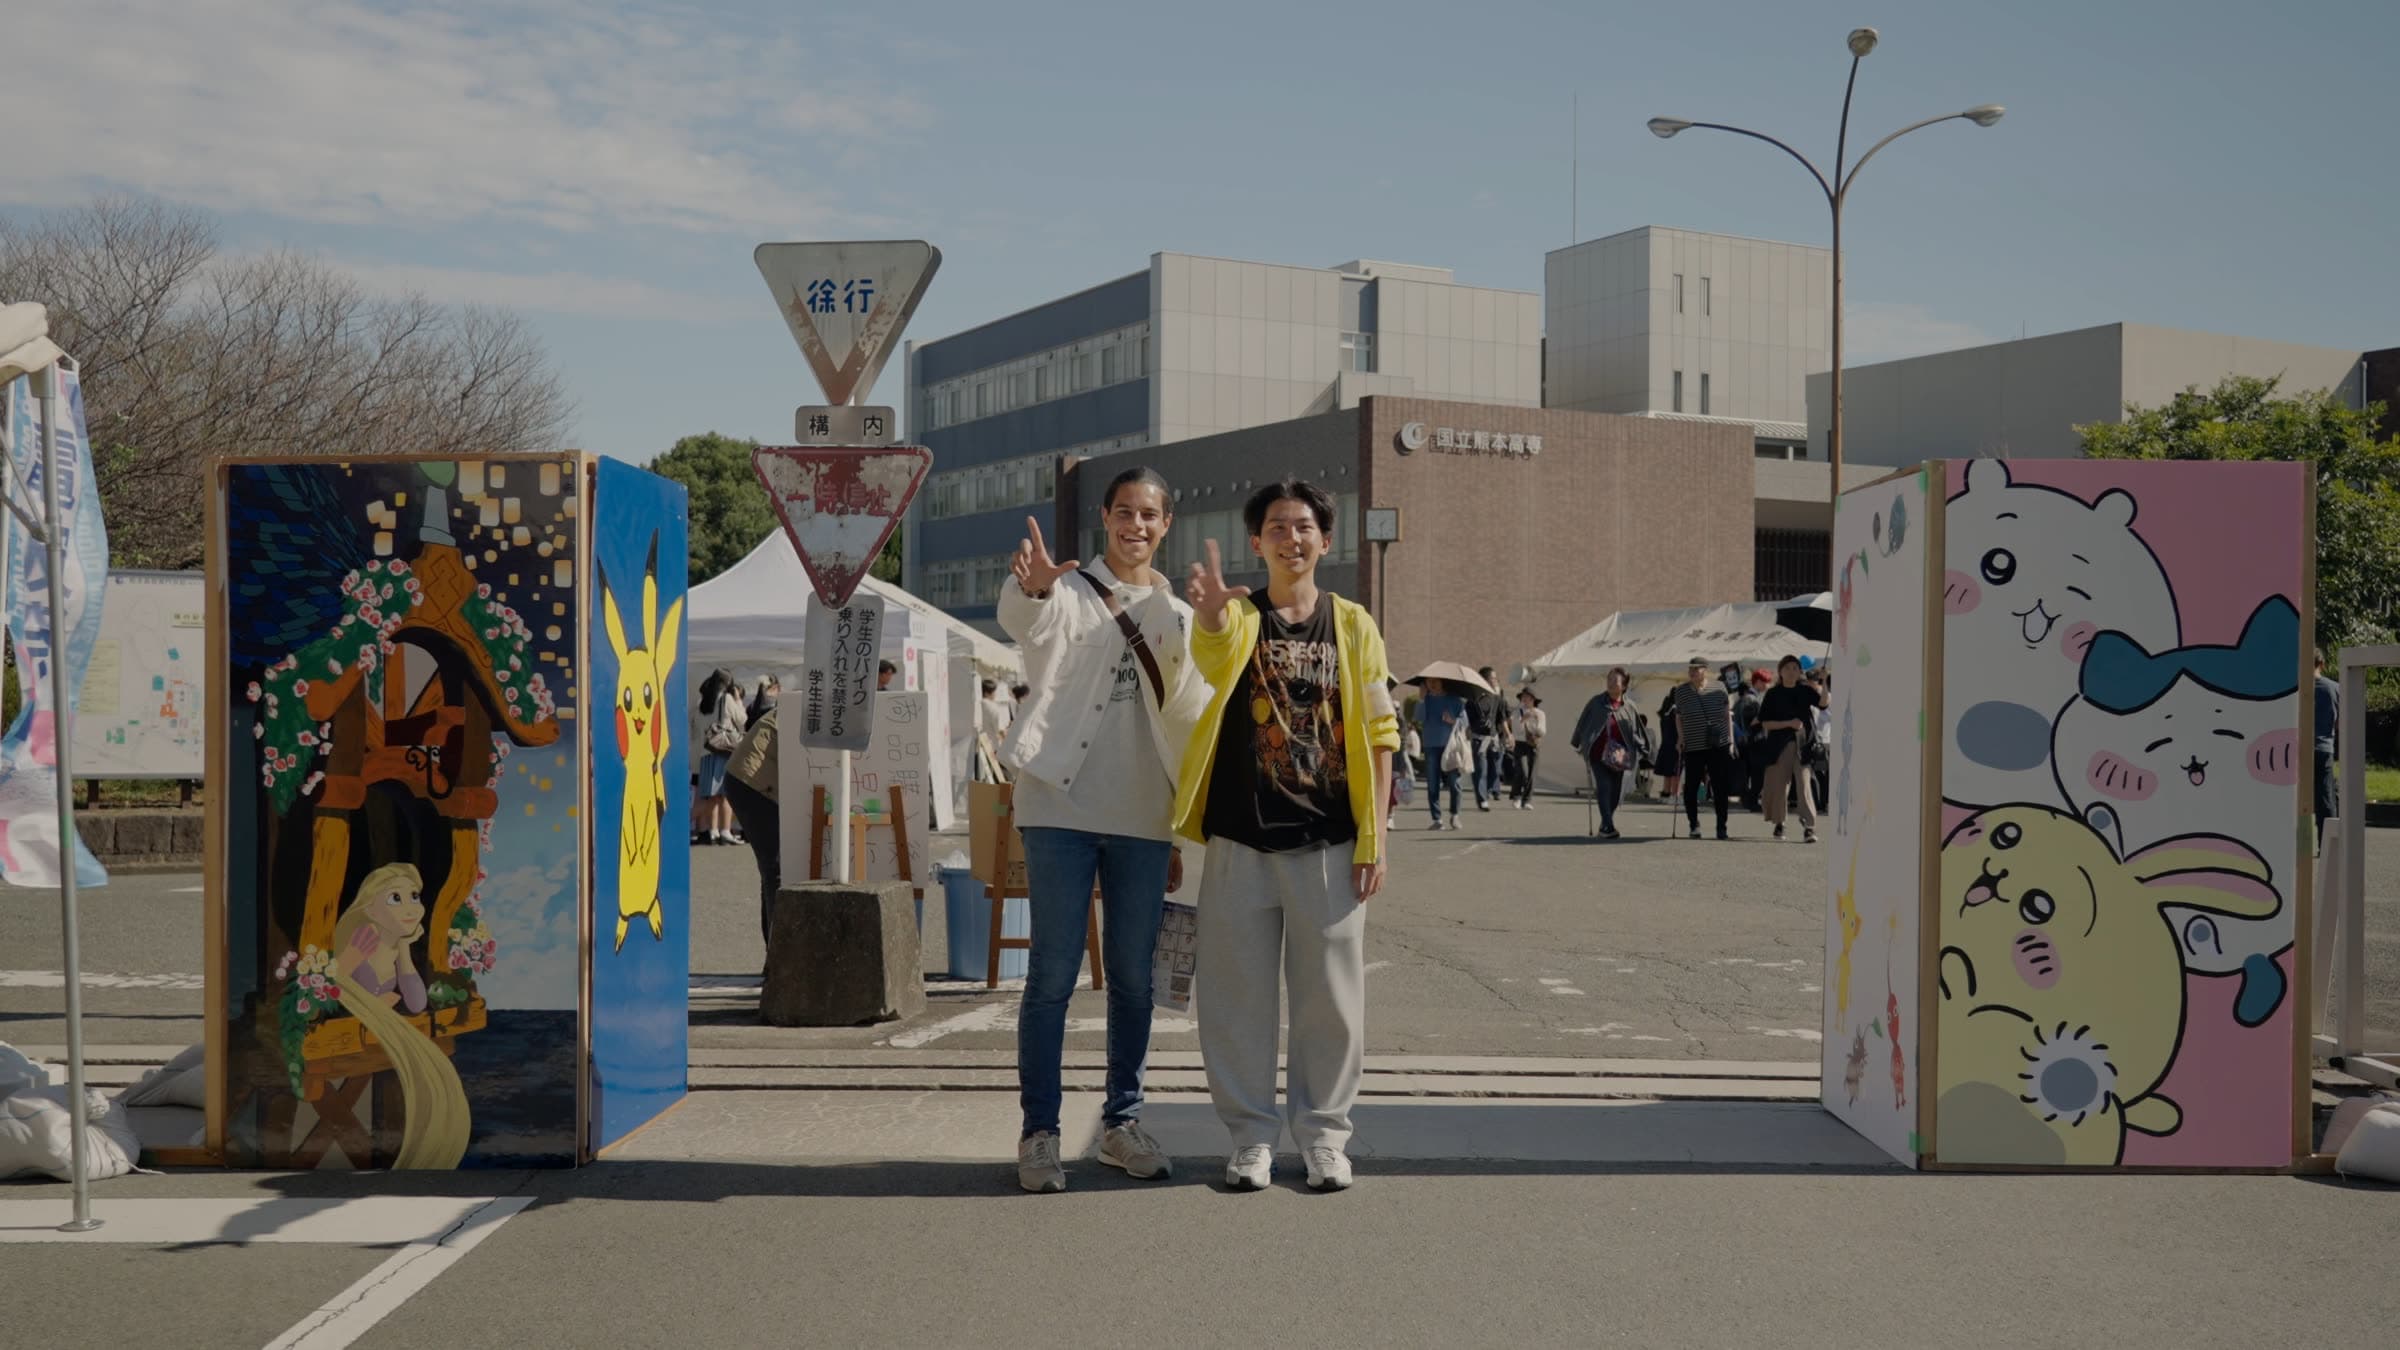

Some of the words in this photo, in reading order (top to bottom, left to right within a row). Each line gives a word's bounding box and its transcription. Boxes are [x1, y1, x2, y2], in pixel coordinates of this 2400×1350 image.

[807, 279, 874, 313] 徐行
[809, 415, 883, 436] 構内
[830, 607, 853, 736] 乗り入れを禁ずる
[853, 609, 875, 705] 学生のバイク
[807, 668, 824, 734] 学生主事
